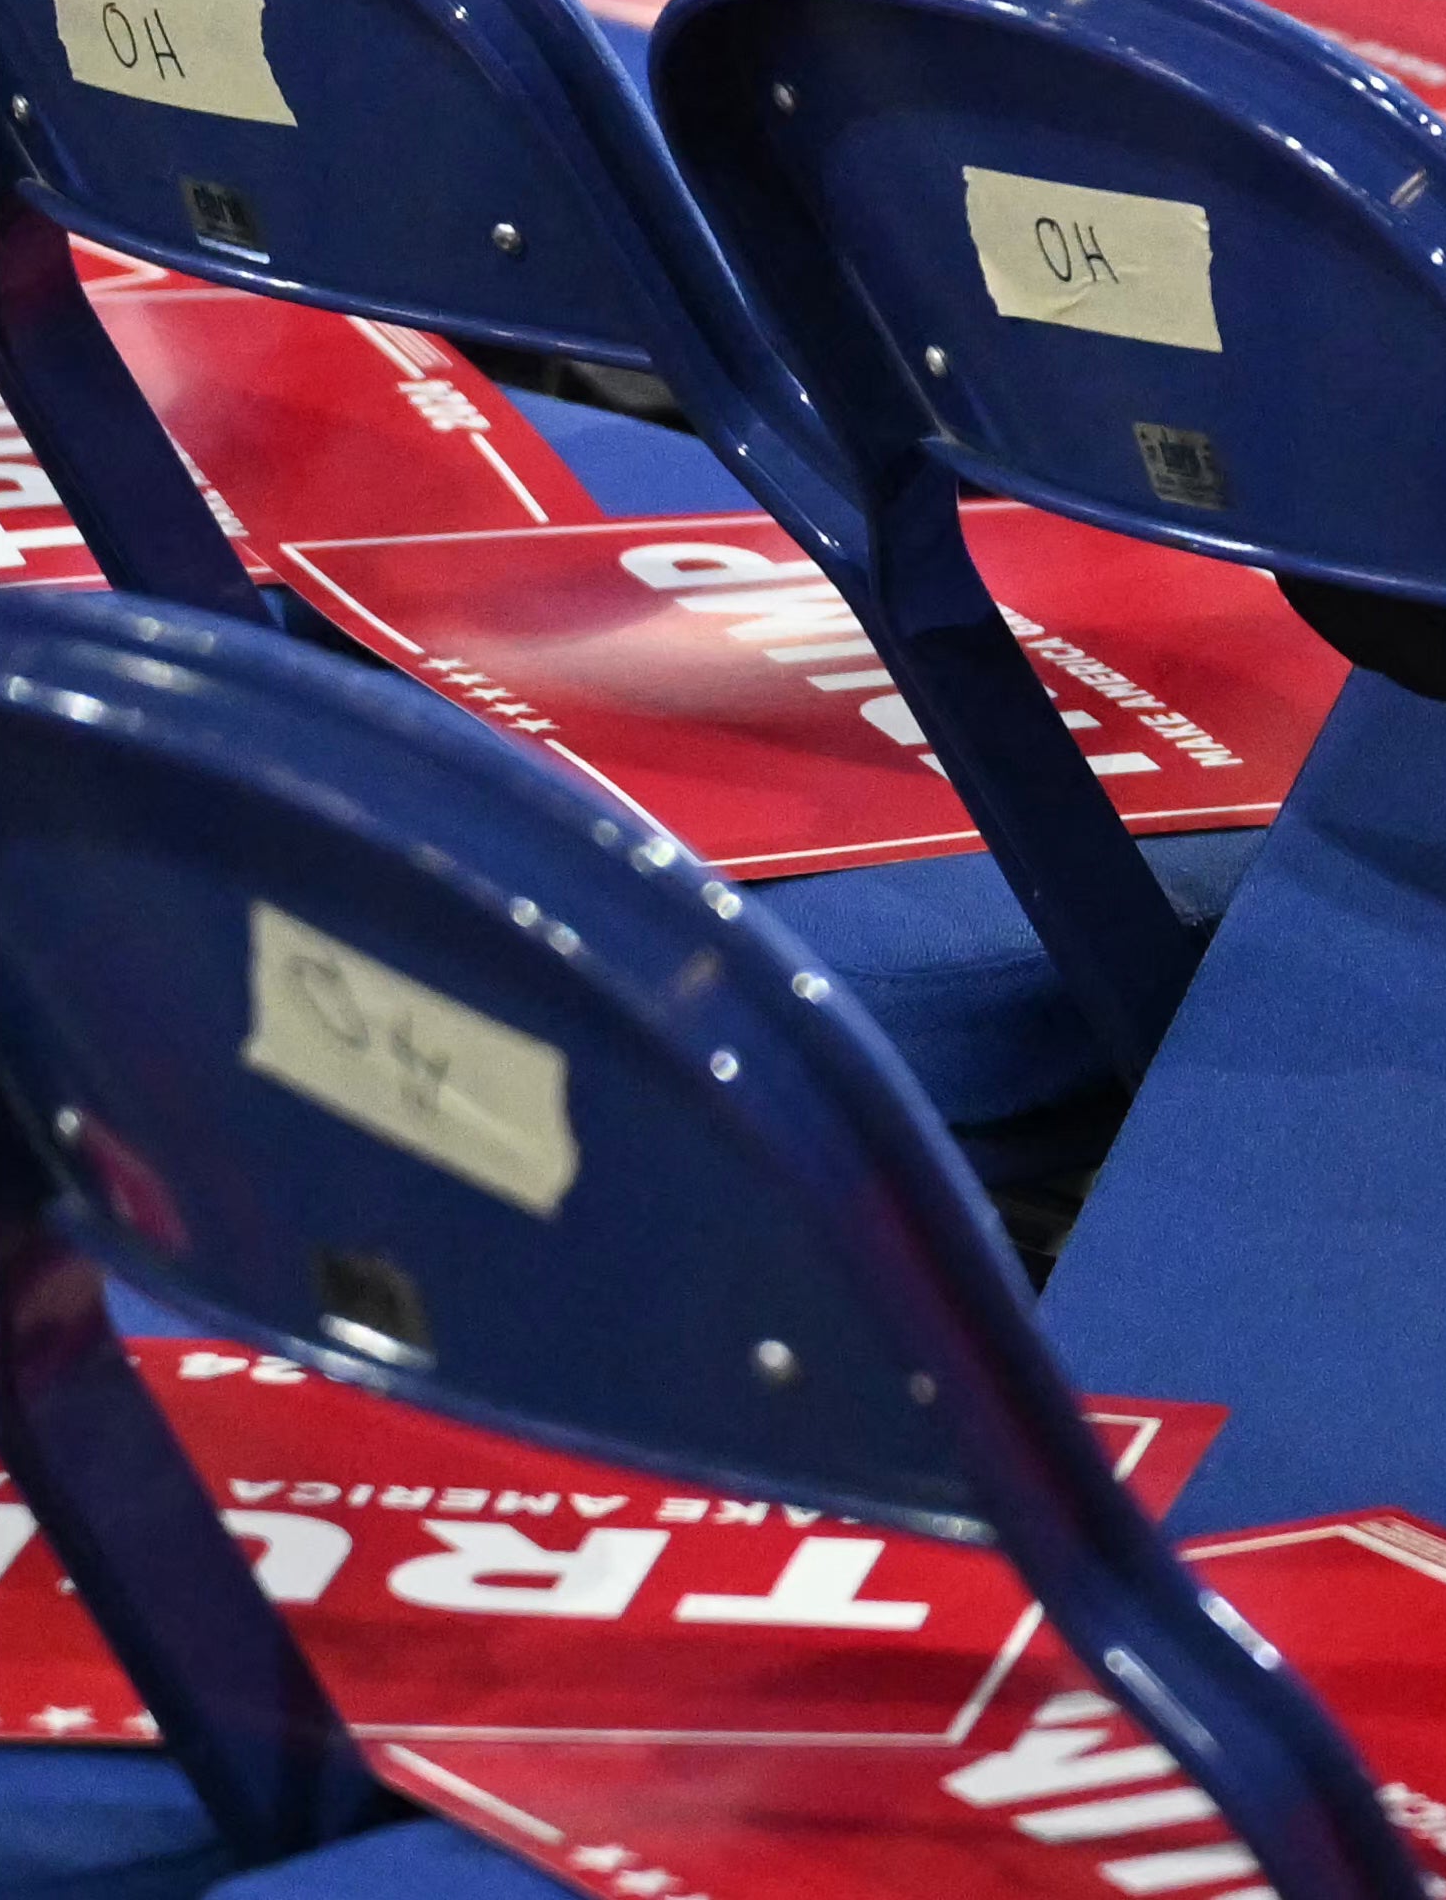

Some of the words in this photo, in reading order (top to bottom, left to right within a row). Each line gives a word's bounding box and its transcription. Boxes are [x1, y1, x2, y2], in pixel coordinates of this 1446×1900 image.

[102, 2, 186, 81] OH
[1035, 216, 1120, 284] OH
[1034, 635, 1165, 715] AMERICA
[1138, 702, 1243, 768] MAKE
[226, 1478, 628, 1522] AMERICA
[657, 1497, 862, 1528] AKE
